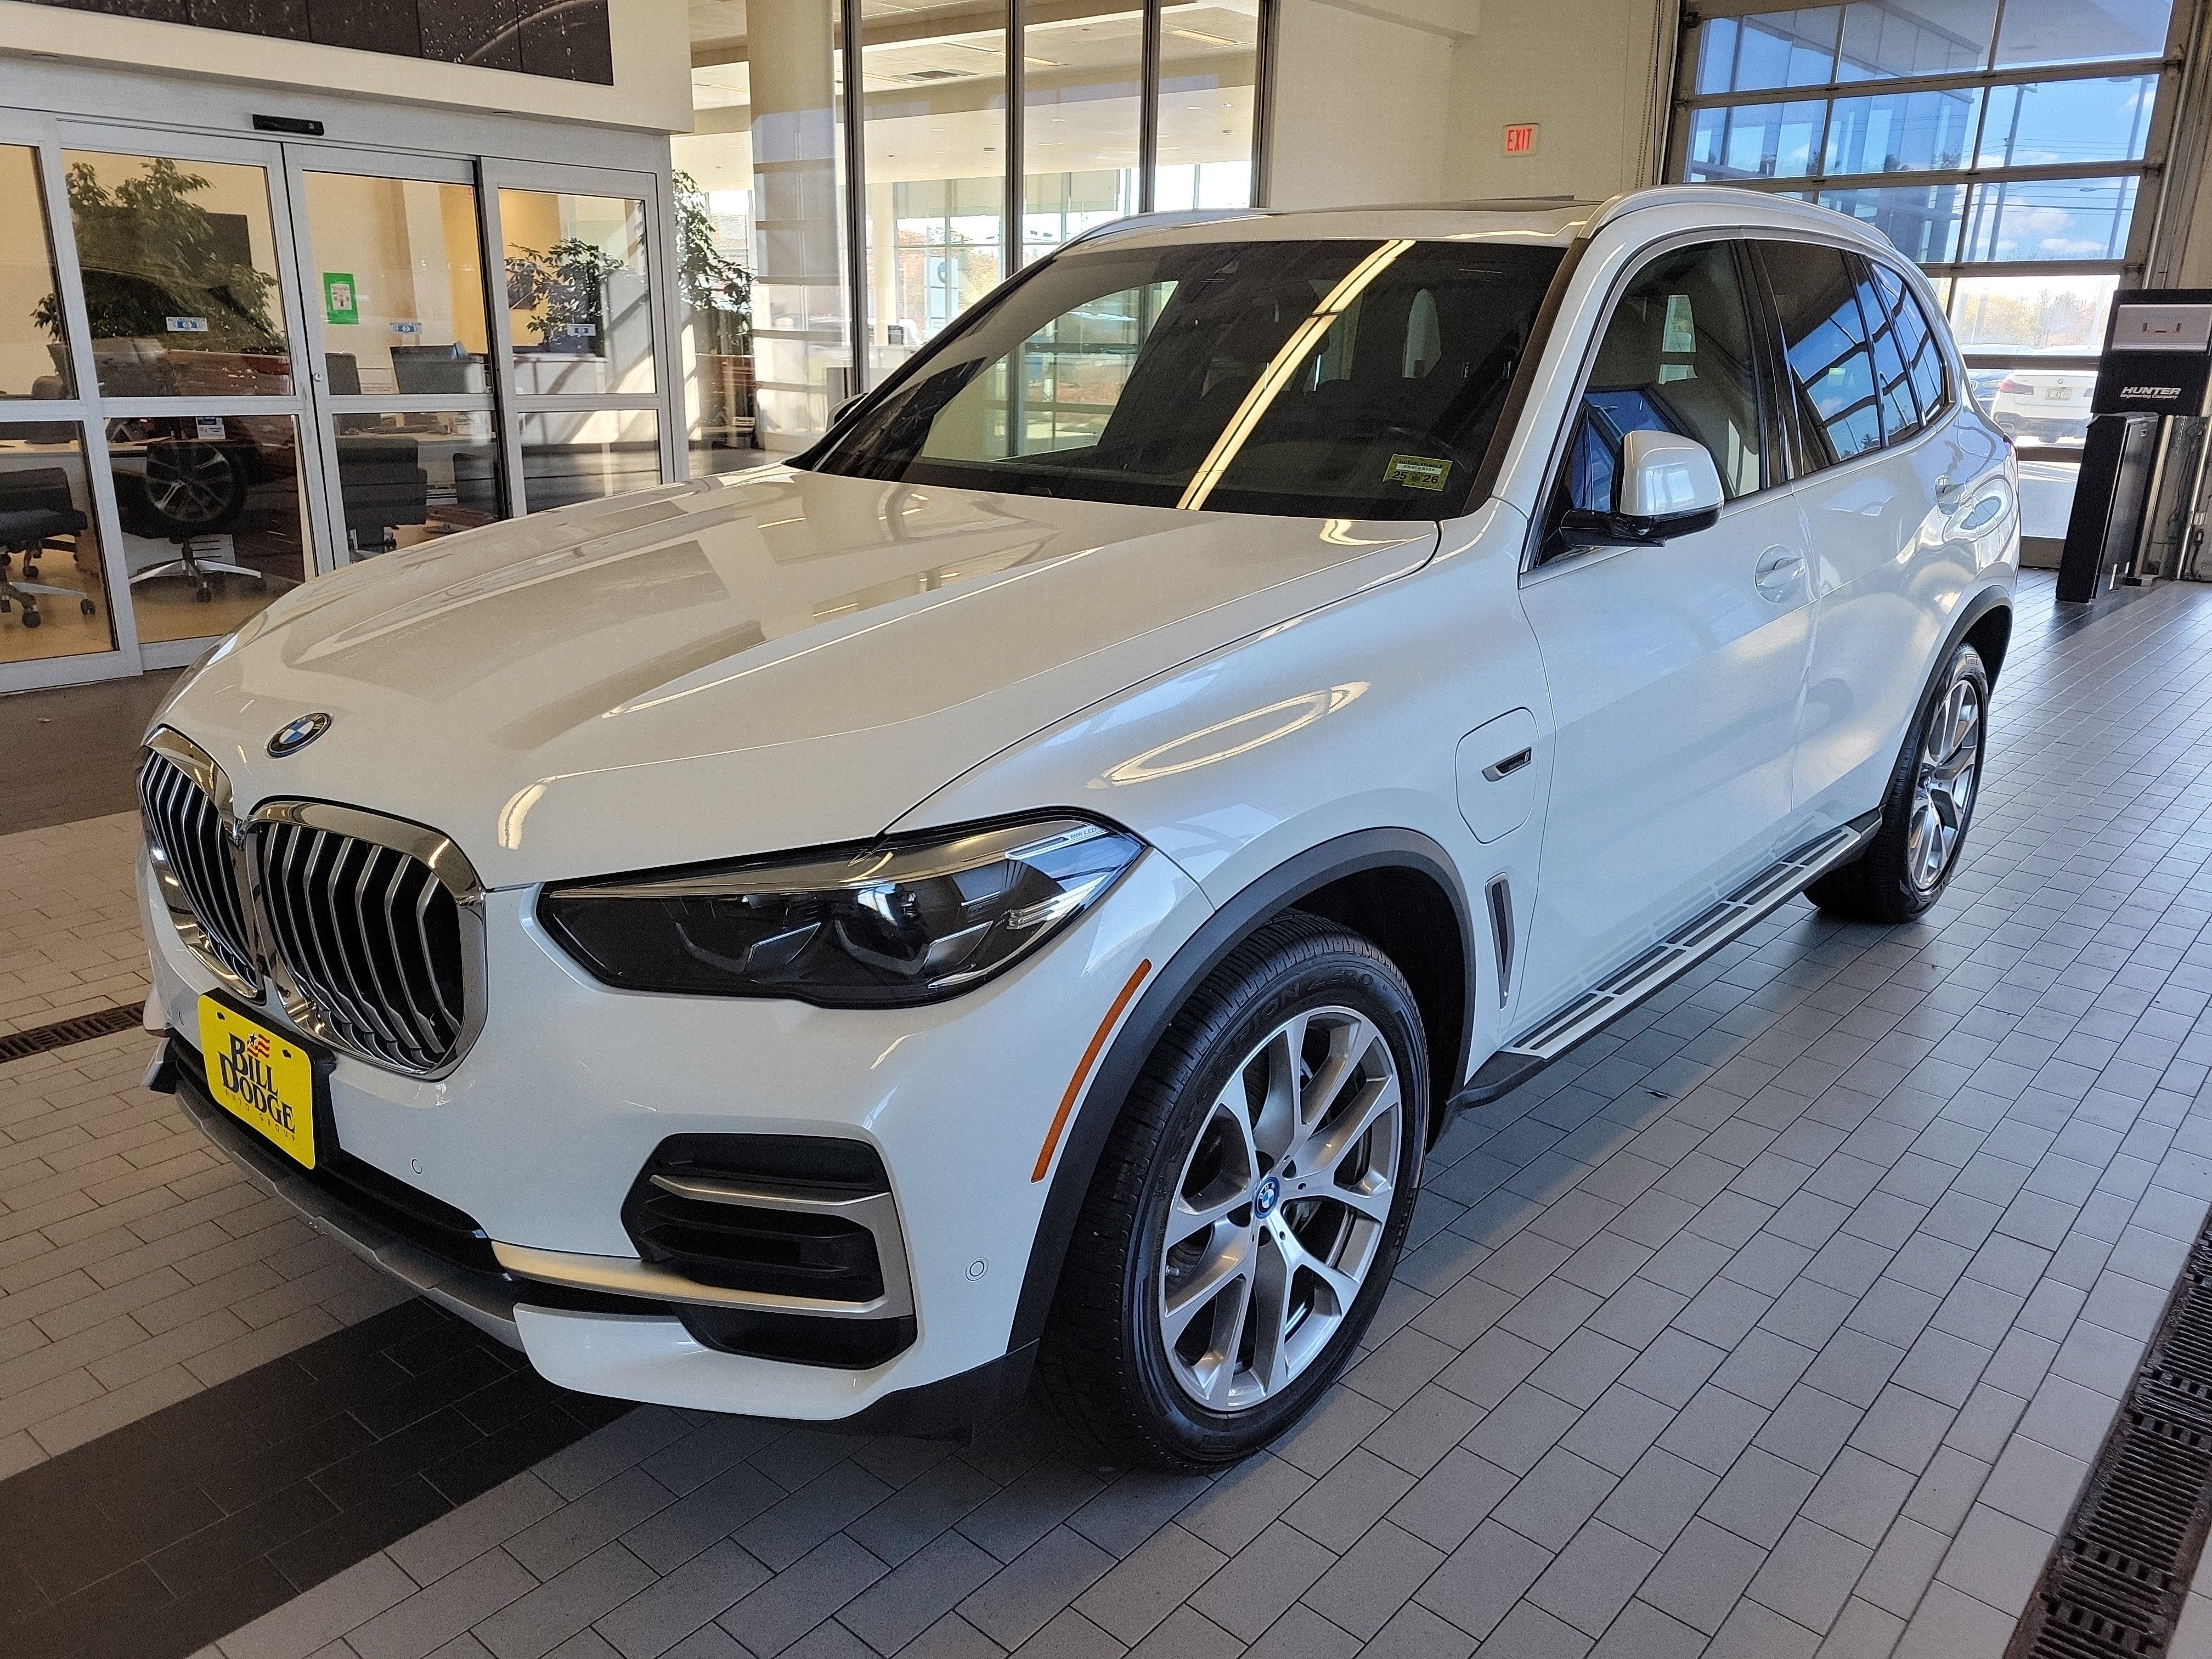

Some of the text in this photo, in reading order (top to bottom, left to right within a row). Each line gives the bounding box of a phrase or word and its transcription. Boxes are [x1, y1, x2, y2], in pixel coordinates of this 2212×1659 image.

[1507, 128, 1532, 151] EXIT
[2121, 386, 2181, 395] HUNTER
[1392, 471, 1408, 479] 25
[1422, 474, 1440, 484] 26
[1070, 831, 1082, 839] BMW
[1307, 969, 1374, 991] ZERO
[228, 1032, 279, 1097] BILL
[217, 1051, 296, 1134] DODGE
[225, 1090, 296, 1143] AUTO GROUP
[1260, 1183, 1276, 1199] BMW
